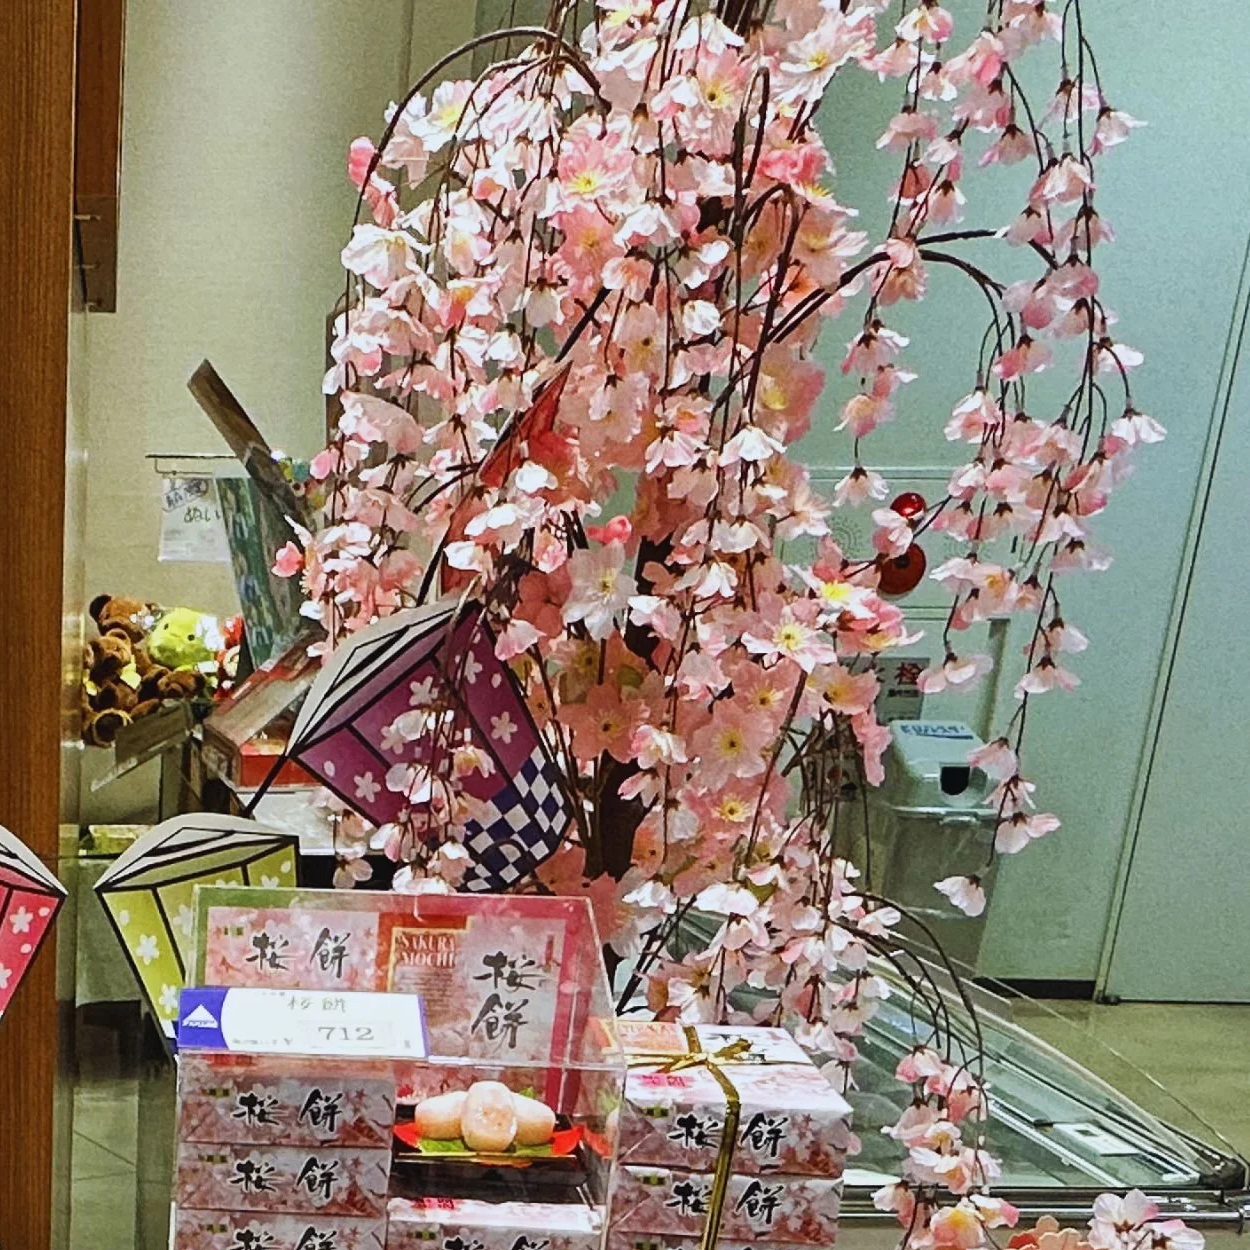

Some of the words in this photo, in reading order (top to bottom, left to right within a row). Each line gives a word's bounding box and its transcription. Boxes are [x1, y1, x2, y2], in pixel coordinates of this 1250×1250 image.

[246, 928, 352, 979] 桜餅
[470, 951, 546, 1049] 桜餅
[316, 1025, 376, 1042] 712
[232, 1089, 345, 1133] 桜餅
[668, 1112, 789, 1157] 桜餅
[229, 1156, 340, 1199] 桜餅
[666, 1181, 785, 1225] 桜餅
